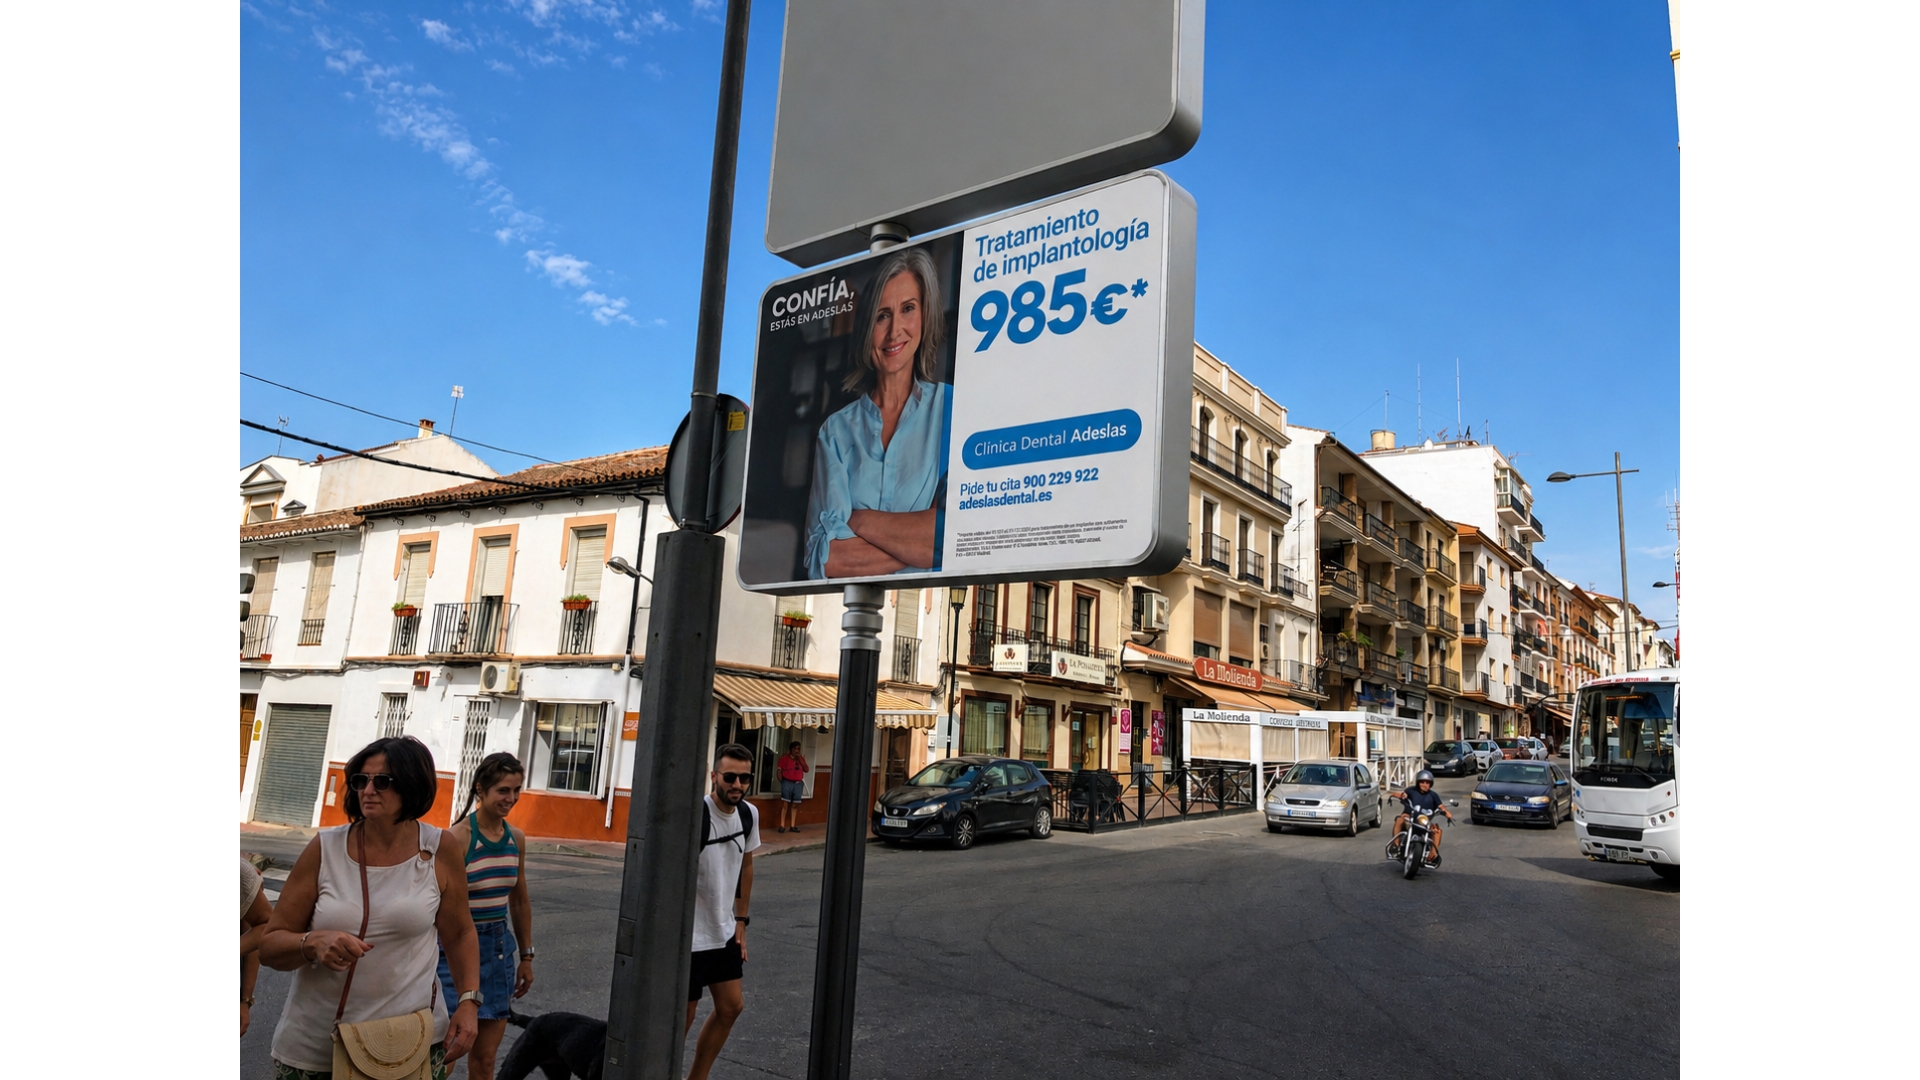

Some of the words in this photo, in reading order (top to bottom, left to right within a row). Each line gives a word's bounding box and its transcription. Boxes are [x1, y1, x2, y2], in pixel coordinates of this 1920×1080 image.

[975, 208, 1099, 257] Tratamiento
[973, 260, 998, 283] de
[1002, 217, 1150, 275] implantología
[772, 276, 855, 317] CONFÍA,
[770, 316, 796, 332] ESTÁS
[797, 312, 810, 325] EN
[811, 301, 854, 321] ADESLAS
[974, 440, 1017, 457] Clínica
[1021, 430, 1067, 450] Dental
[1070, 422, 1127, 443] Adeslas
[960, 482, 984, 496] Pide
[986, 481, 998, 493] tu
[1000, 477, 1021, 492] cita
[1023, 474, 1046, 489] 900
[1048, 471, 1072, 486] 229
[1075, 467, 1099, 483] 922
[959, 490, 1053, 511] adeslasdental.es
[1203, 660, 1215, 679] La
[1216, 664, 1257, 688] Molienda
[1193, 711, 1205, 719] La
[1207, 711, 1251, 722] Molienda
